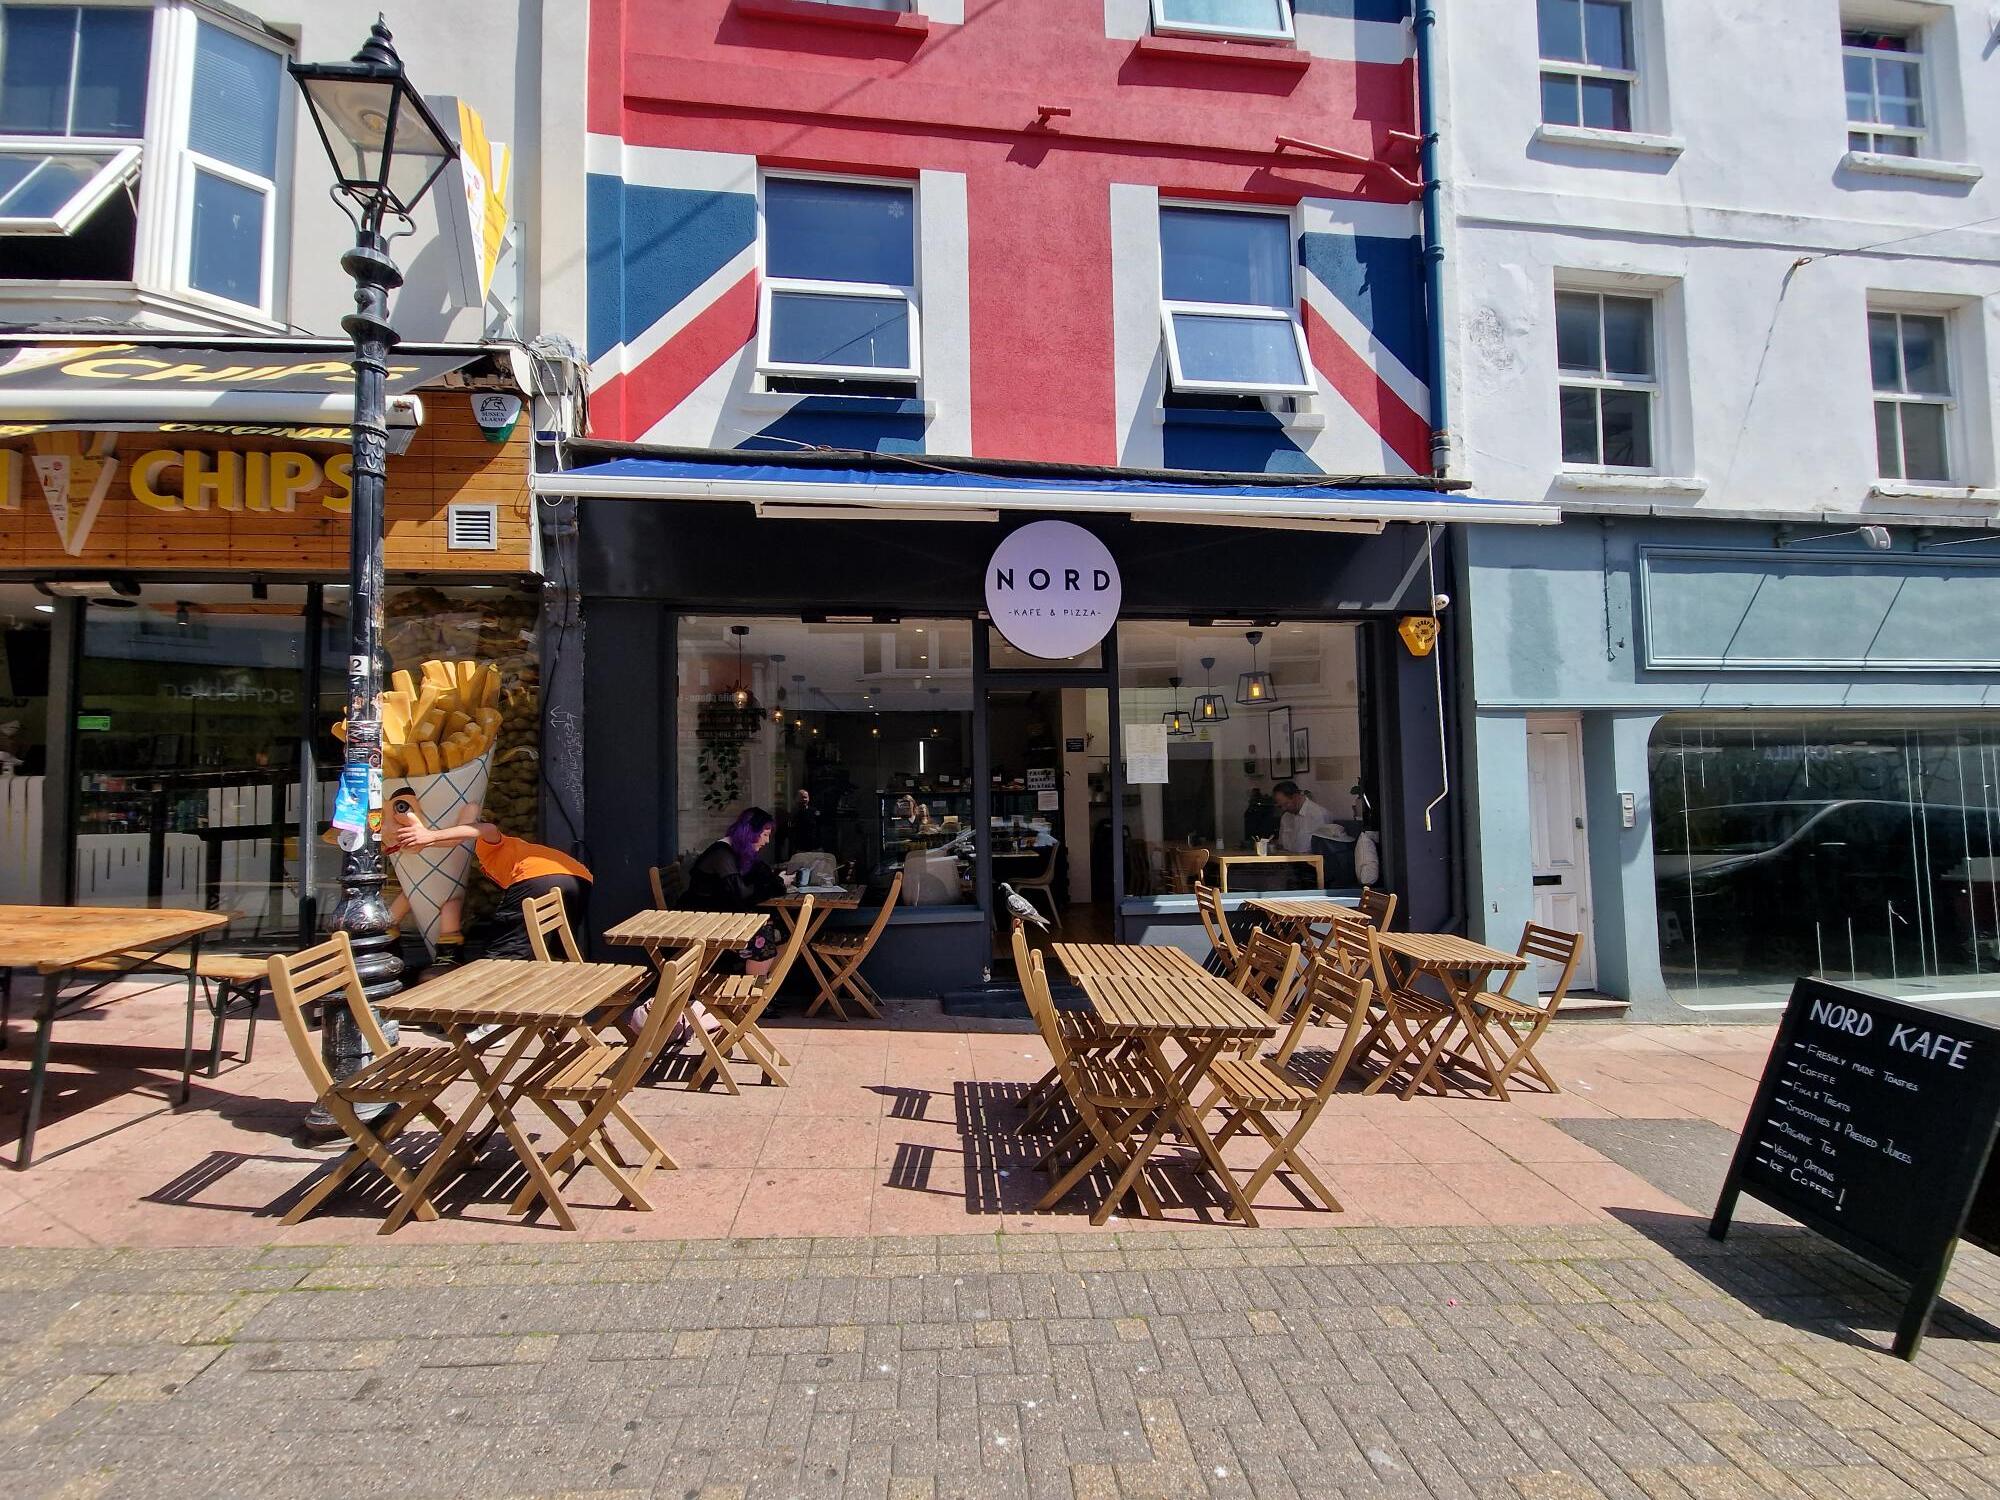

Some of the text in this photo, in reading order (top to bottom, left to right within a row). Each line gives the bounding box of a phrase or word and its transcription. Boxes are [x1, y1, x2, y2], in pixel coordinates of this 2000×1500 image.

[61, 358, 420, 382] CHIPS
[158, 423, 352, 439] ORIGINAL
[130, 449, 352, 510] CHIPS
[996, 568, 1111, 591] NORD
[1809, 999, 1873, 1037] NORD
[1799, 1063, 1837, 1085] COFFEE
[1807, 1043, 1920, 1092] FRESHLY MADE TOASTIES
[1793, 1081, 1812, 1098] FIKA
[1822, 1091, 1851, 1113] TREATS
[1779, 1121, 1837, 1157] ORGANIC TEA
[1786, 1099, 1831, 1128] SMOOTHIES
[1844, 1122, 1878, 1149] PRESSED
[1882, 1138, 1913, 1165] JUICES
[1769, 1159, 1785, 1174] ICE
[1773, 1142, 1835, 1183] VEGAN OPTIONS
